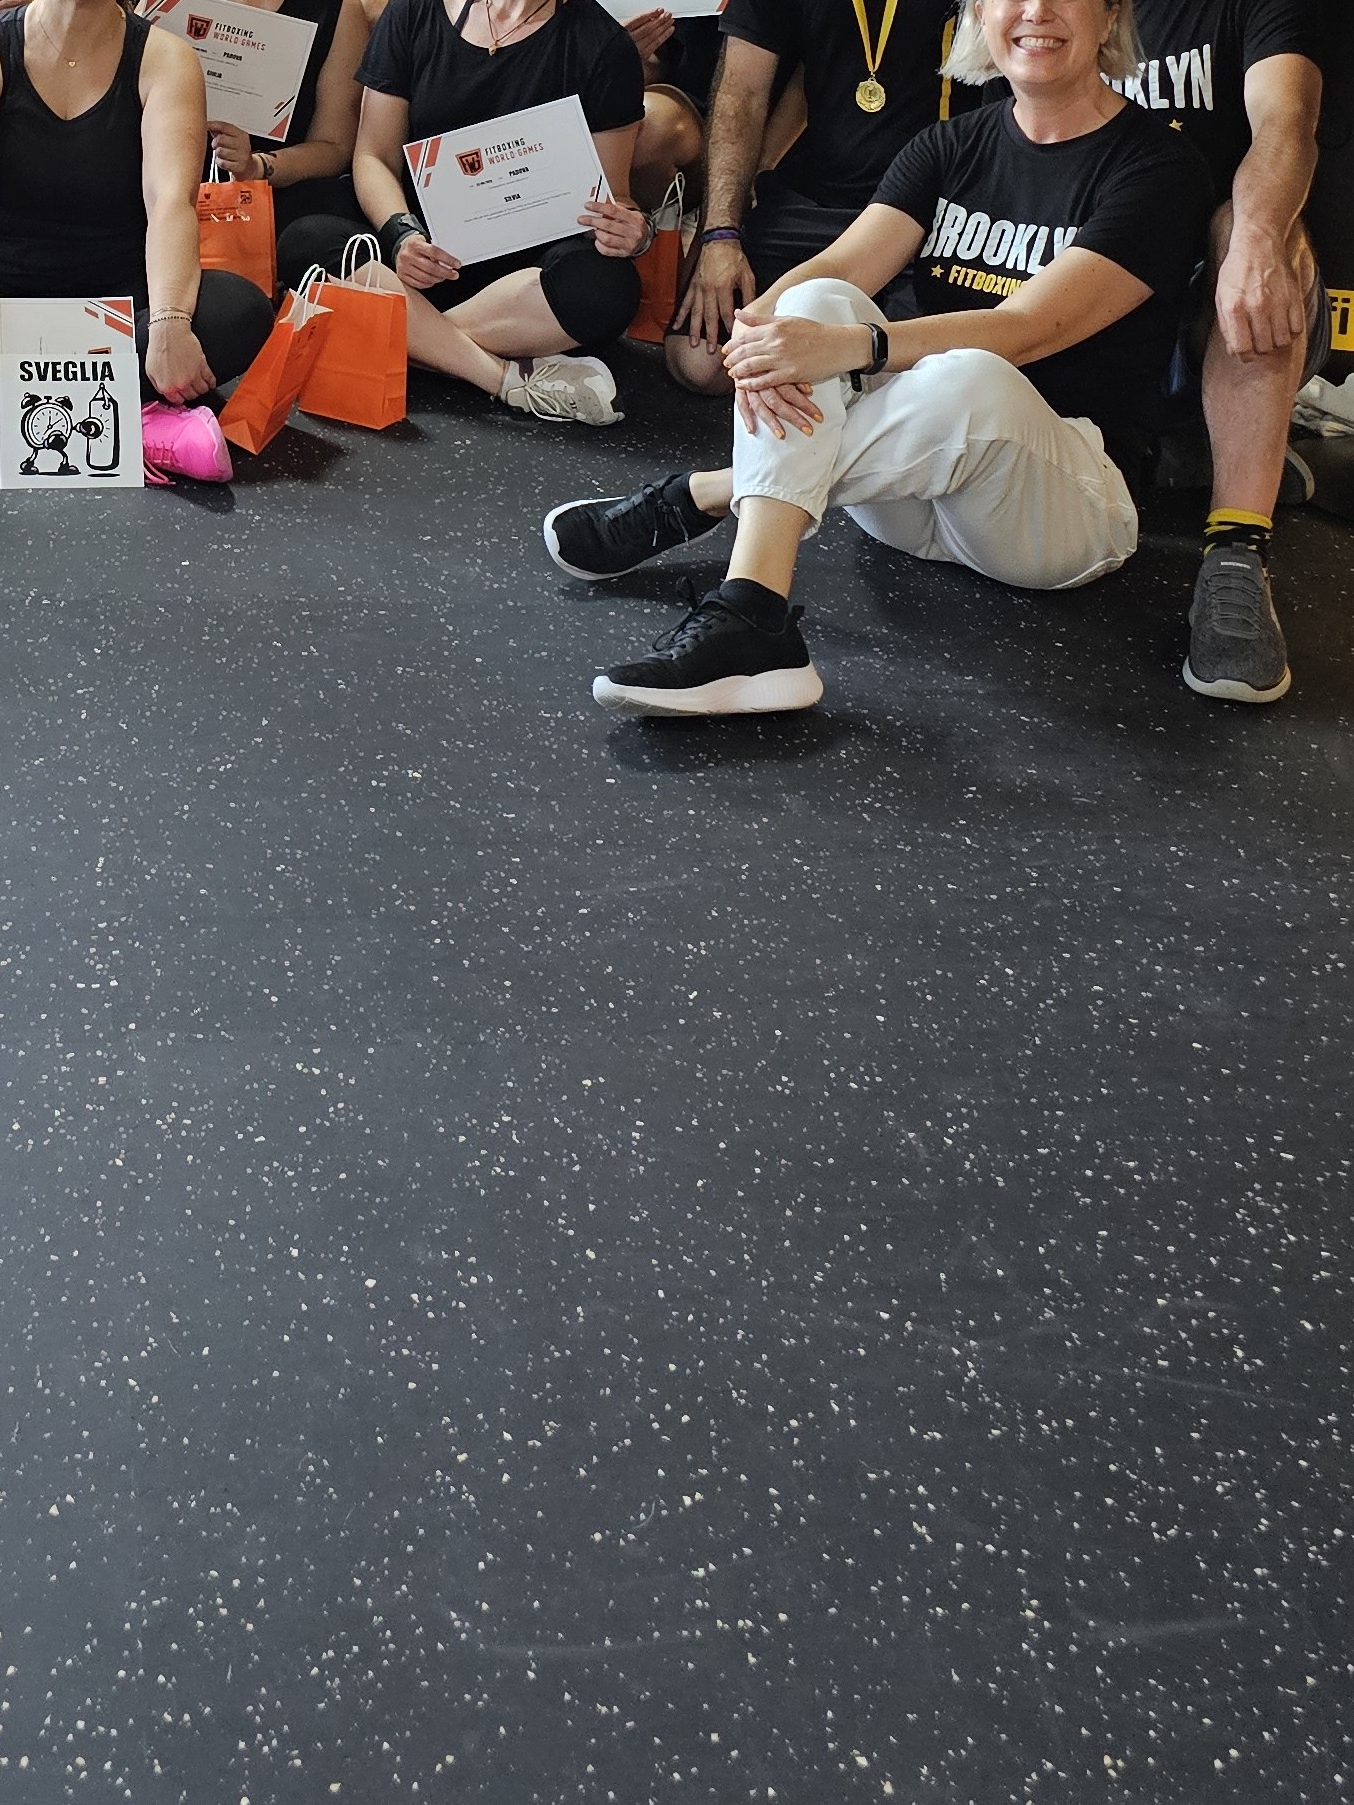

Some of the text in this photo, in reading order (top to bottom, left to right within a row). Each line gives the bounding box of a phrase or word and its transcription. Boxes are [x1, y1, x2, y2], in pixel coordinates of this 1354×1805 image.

[214, 22, 254, 38] FITBOXING
[213, 31, 266, 51] WORLD GAMES
[1100, 43, 1214, 111] KLYN
[484, 137, 526, 156] FITBOXING
[487, 142, 545, 165] WORLD GAMES
[19, 360, 115, 382] SVEGLIA
